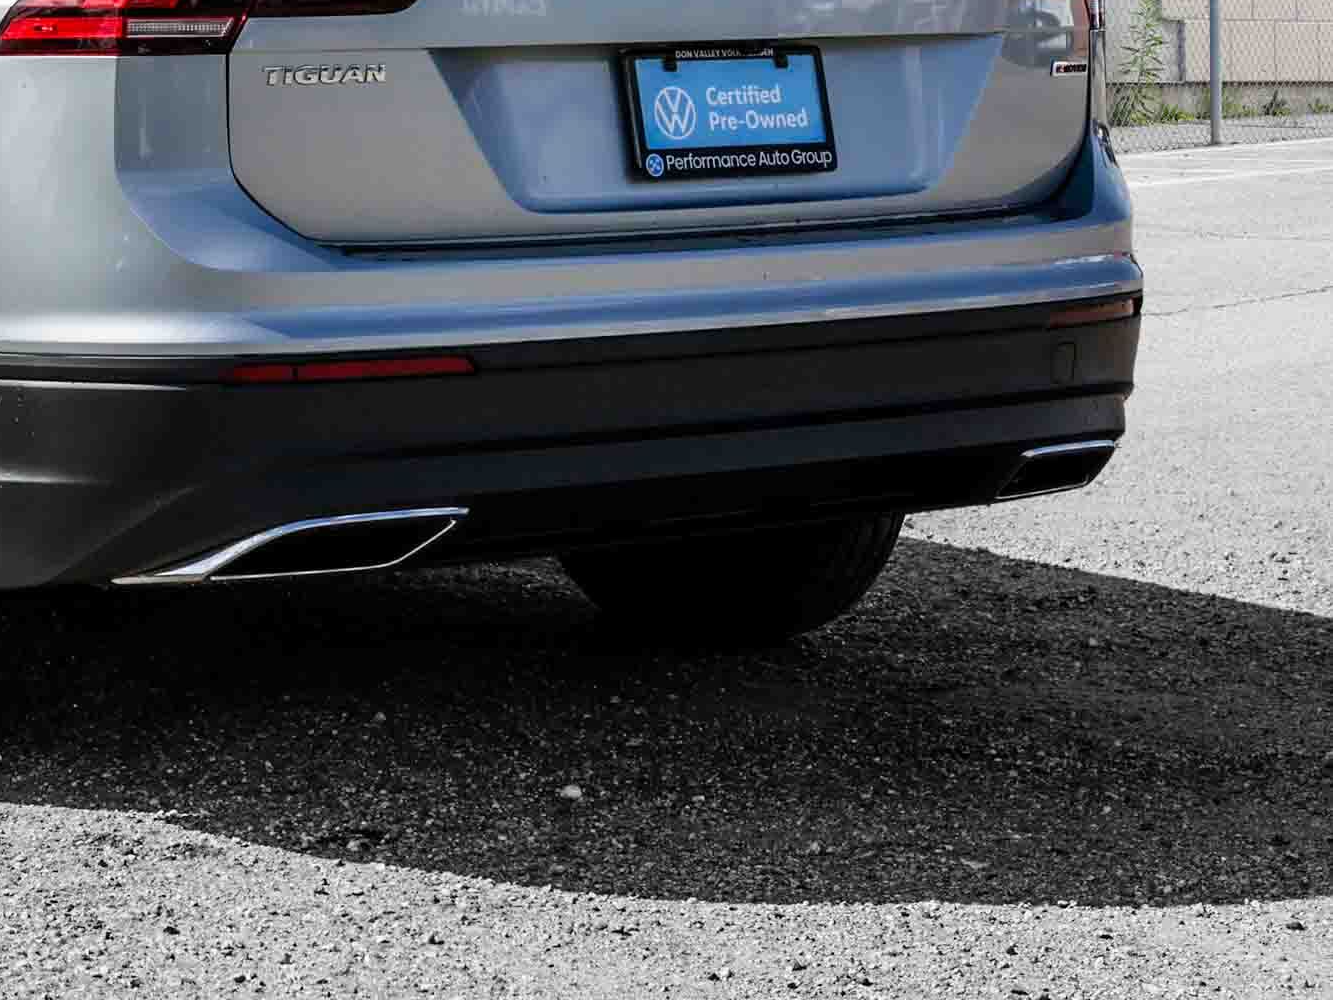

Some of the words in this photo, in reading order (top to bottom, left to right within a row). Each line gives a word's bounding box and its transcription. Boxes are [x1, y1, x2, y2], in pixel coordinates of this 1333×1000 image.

[263, 63, 387, 87] TIGUAN
[706, 84, 781, 105] Certified
[709, 108, 808, 131] Pre-Owned
[666, 153, 756, 171] Performance
[759, 151, 790, 167] Auto
[791, 149, 833, 169] Group
